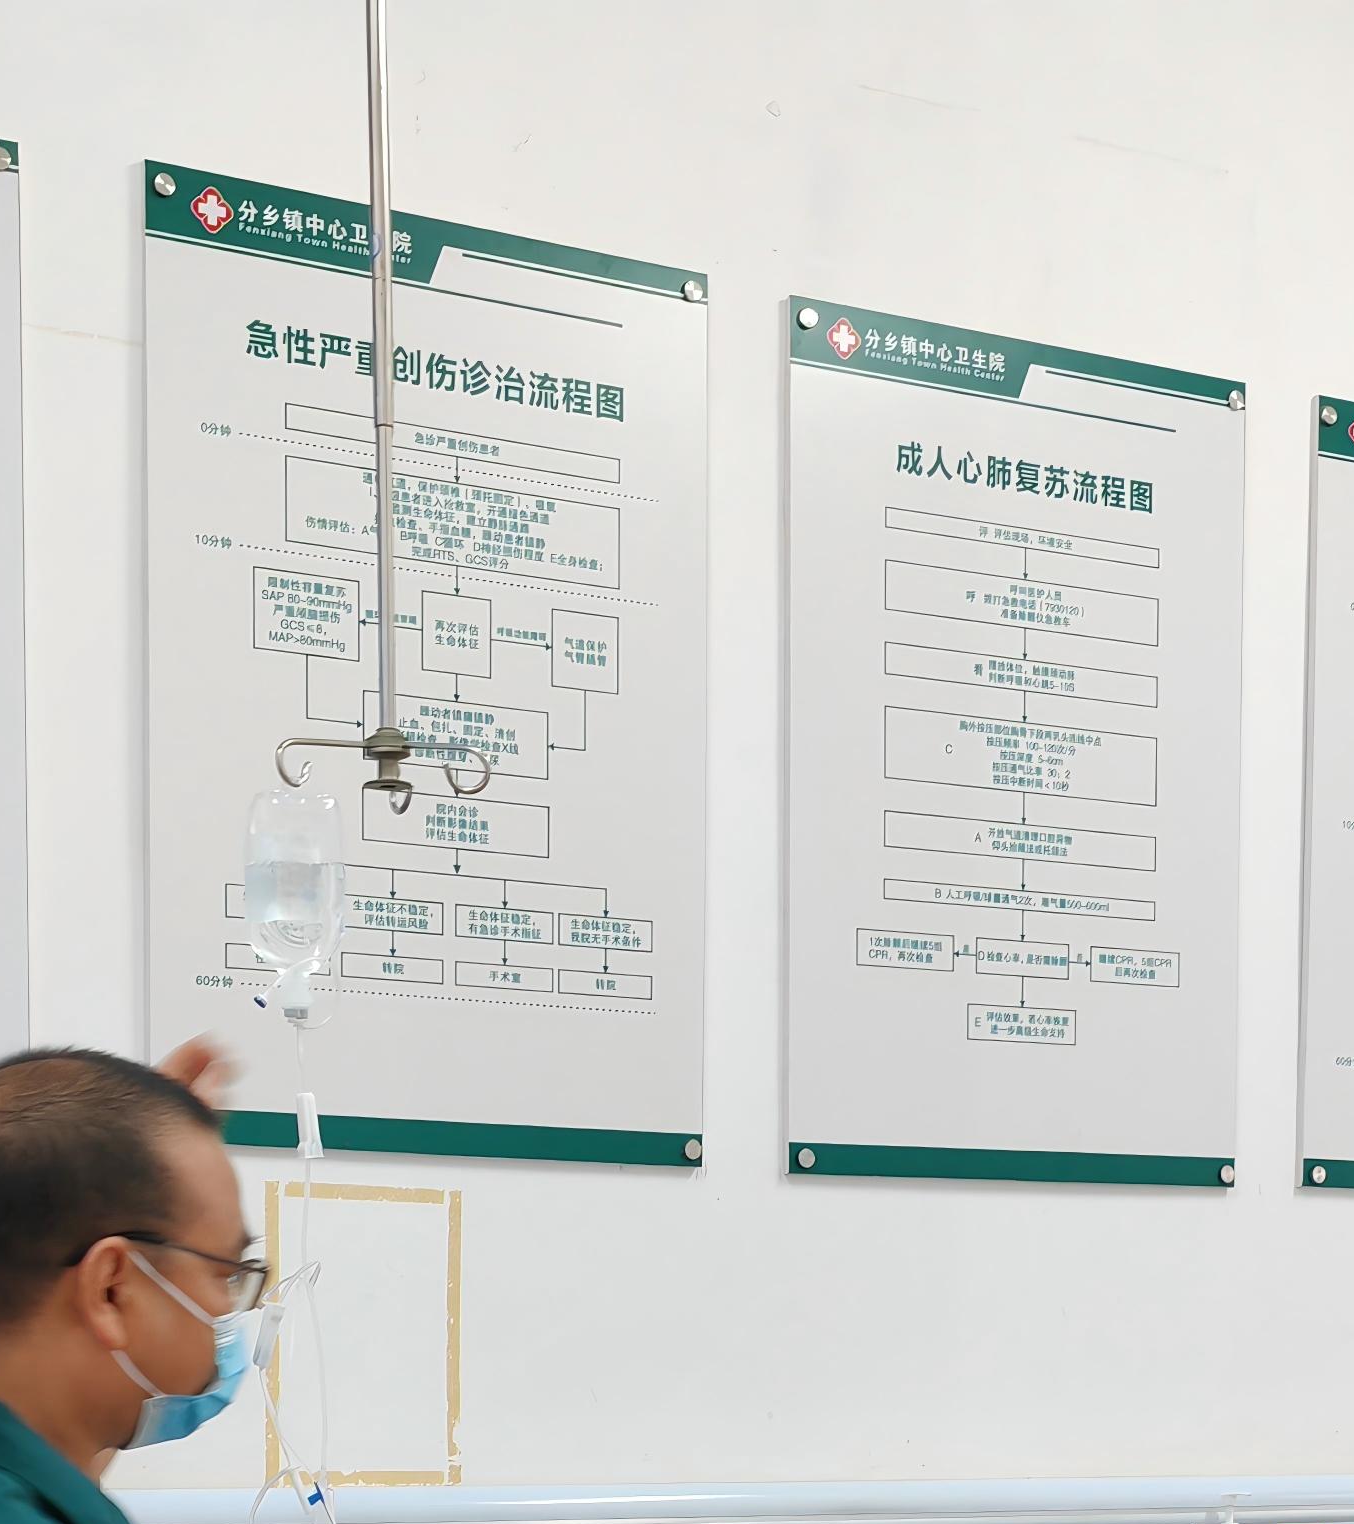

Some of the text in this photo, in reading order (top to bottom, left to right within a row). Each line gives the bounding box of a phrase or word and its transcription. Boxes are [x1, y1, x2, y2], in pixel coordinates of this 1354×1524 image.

[238, 200, 413, 254] 分乡镇中心卫院
[238, 222, 370, 256] Fenxiang Town Health
[865, 328, 1006, 373] 分乡镇中心卫生院
[911, 357, 937, 369] Town
[940, 364, 971, 376] Health
[973, 370, 1004, 382] Center
[201, 422, 231, 437] 0分钟
[895, 440, 1154, 515] 成人心肺复苏流程图
[195, 534, 232, 549] 10分钟
[262, 589, 284, 601] SAP
[435, 619, 479, 636] 再次评估
[435, 635, 479, 650] 生命体征
[945, 744, 953, 754] C
[975, 832, 982, 842] A
[194, 974, 235, 990] 60分钟
[975, 1017, 981, 1027] E
